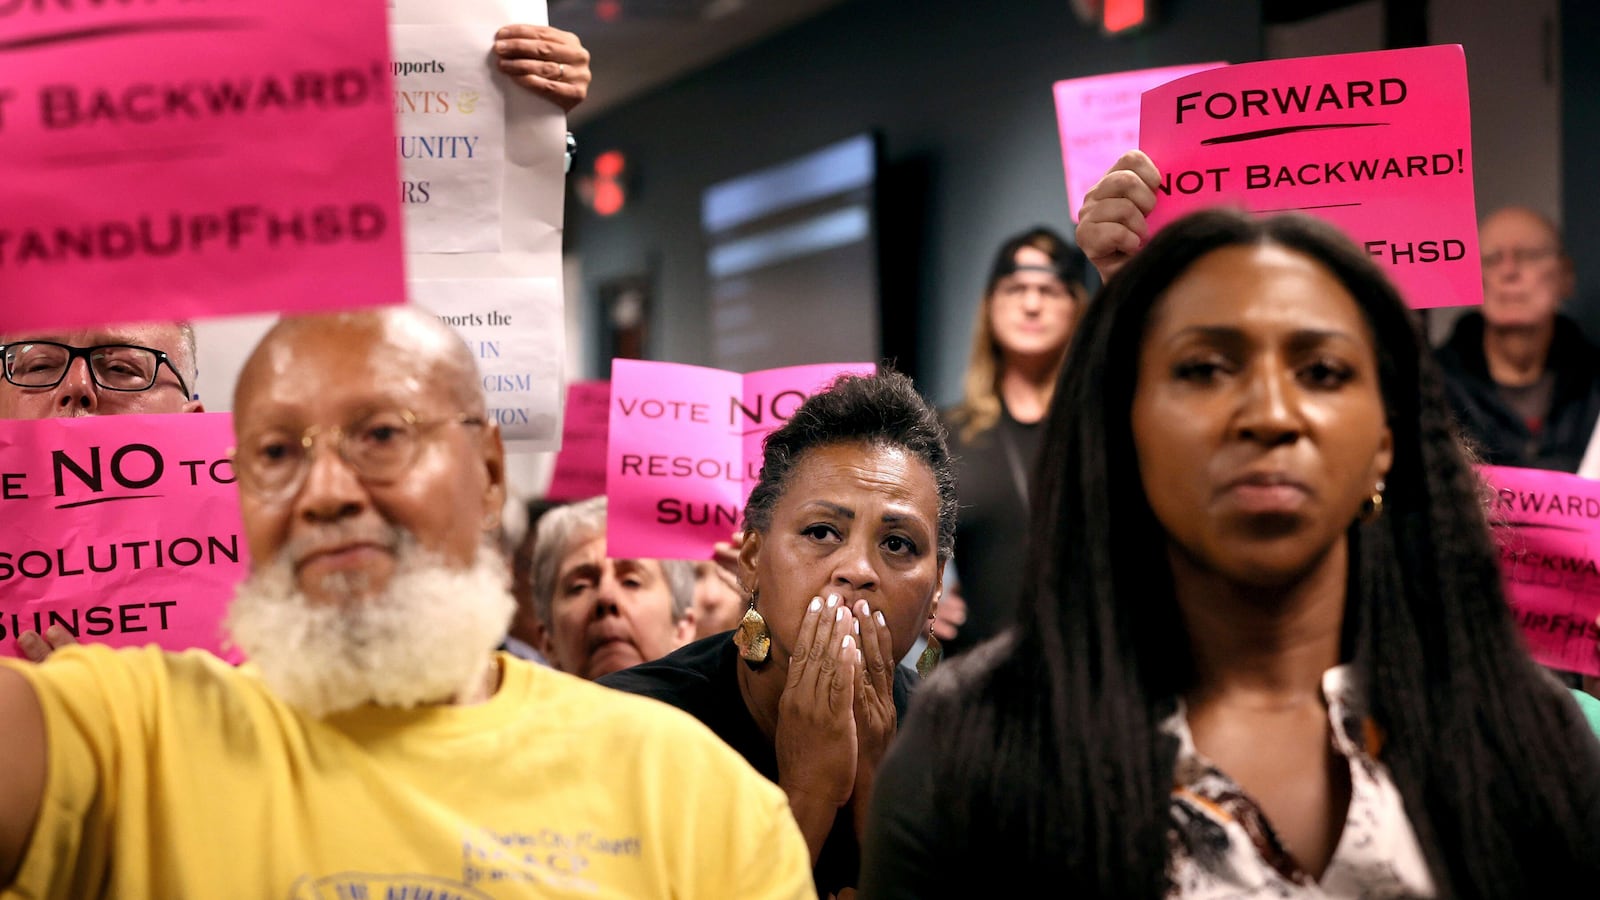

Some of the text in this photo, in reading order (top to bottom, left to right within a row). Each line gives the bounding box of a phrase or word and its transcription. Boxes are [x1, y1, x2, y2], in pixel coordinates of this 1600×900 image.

[390, 59, 445, 76] pports
[1175, 78, 1408, 125] FORWARD
[395, 136, 479, 159] UNITY
[1245, 148, 1466, 191] BACKWARD!
[487, 311, 512, 326] the
[480, 341, 499, 358] IN
[617, 397, 711, 423] VOTE
[52, 443, 164, 496] NO
[179, 458, 237, 486] TO
[0, 601, 176, 640] UNSET
